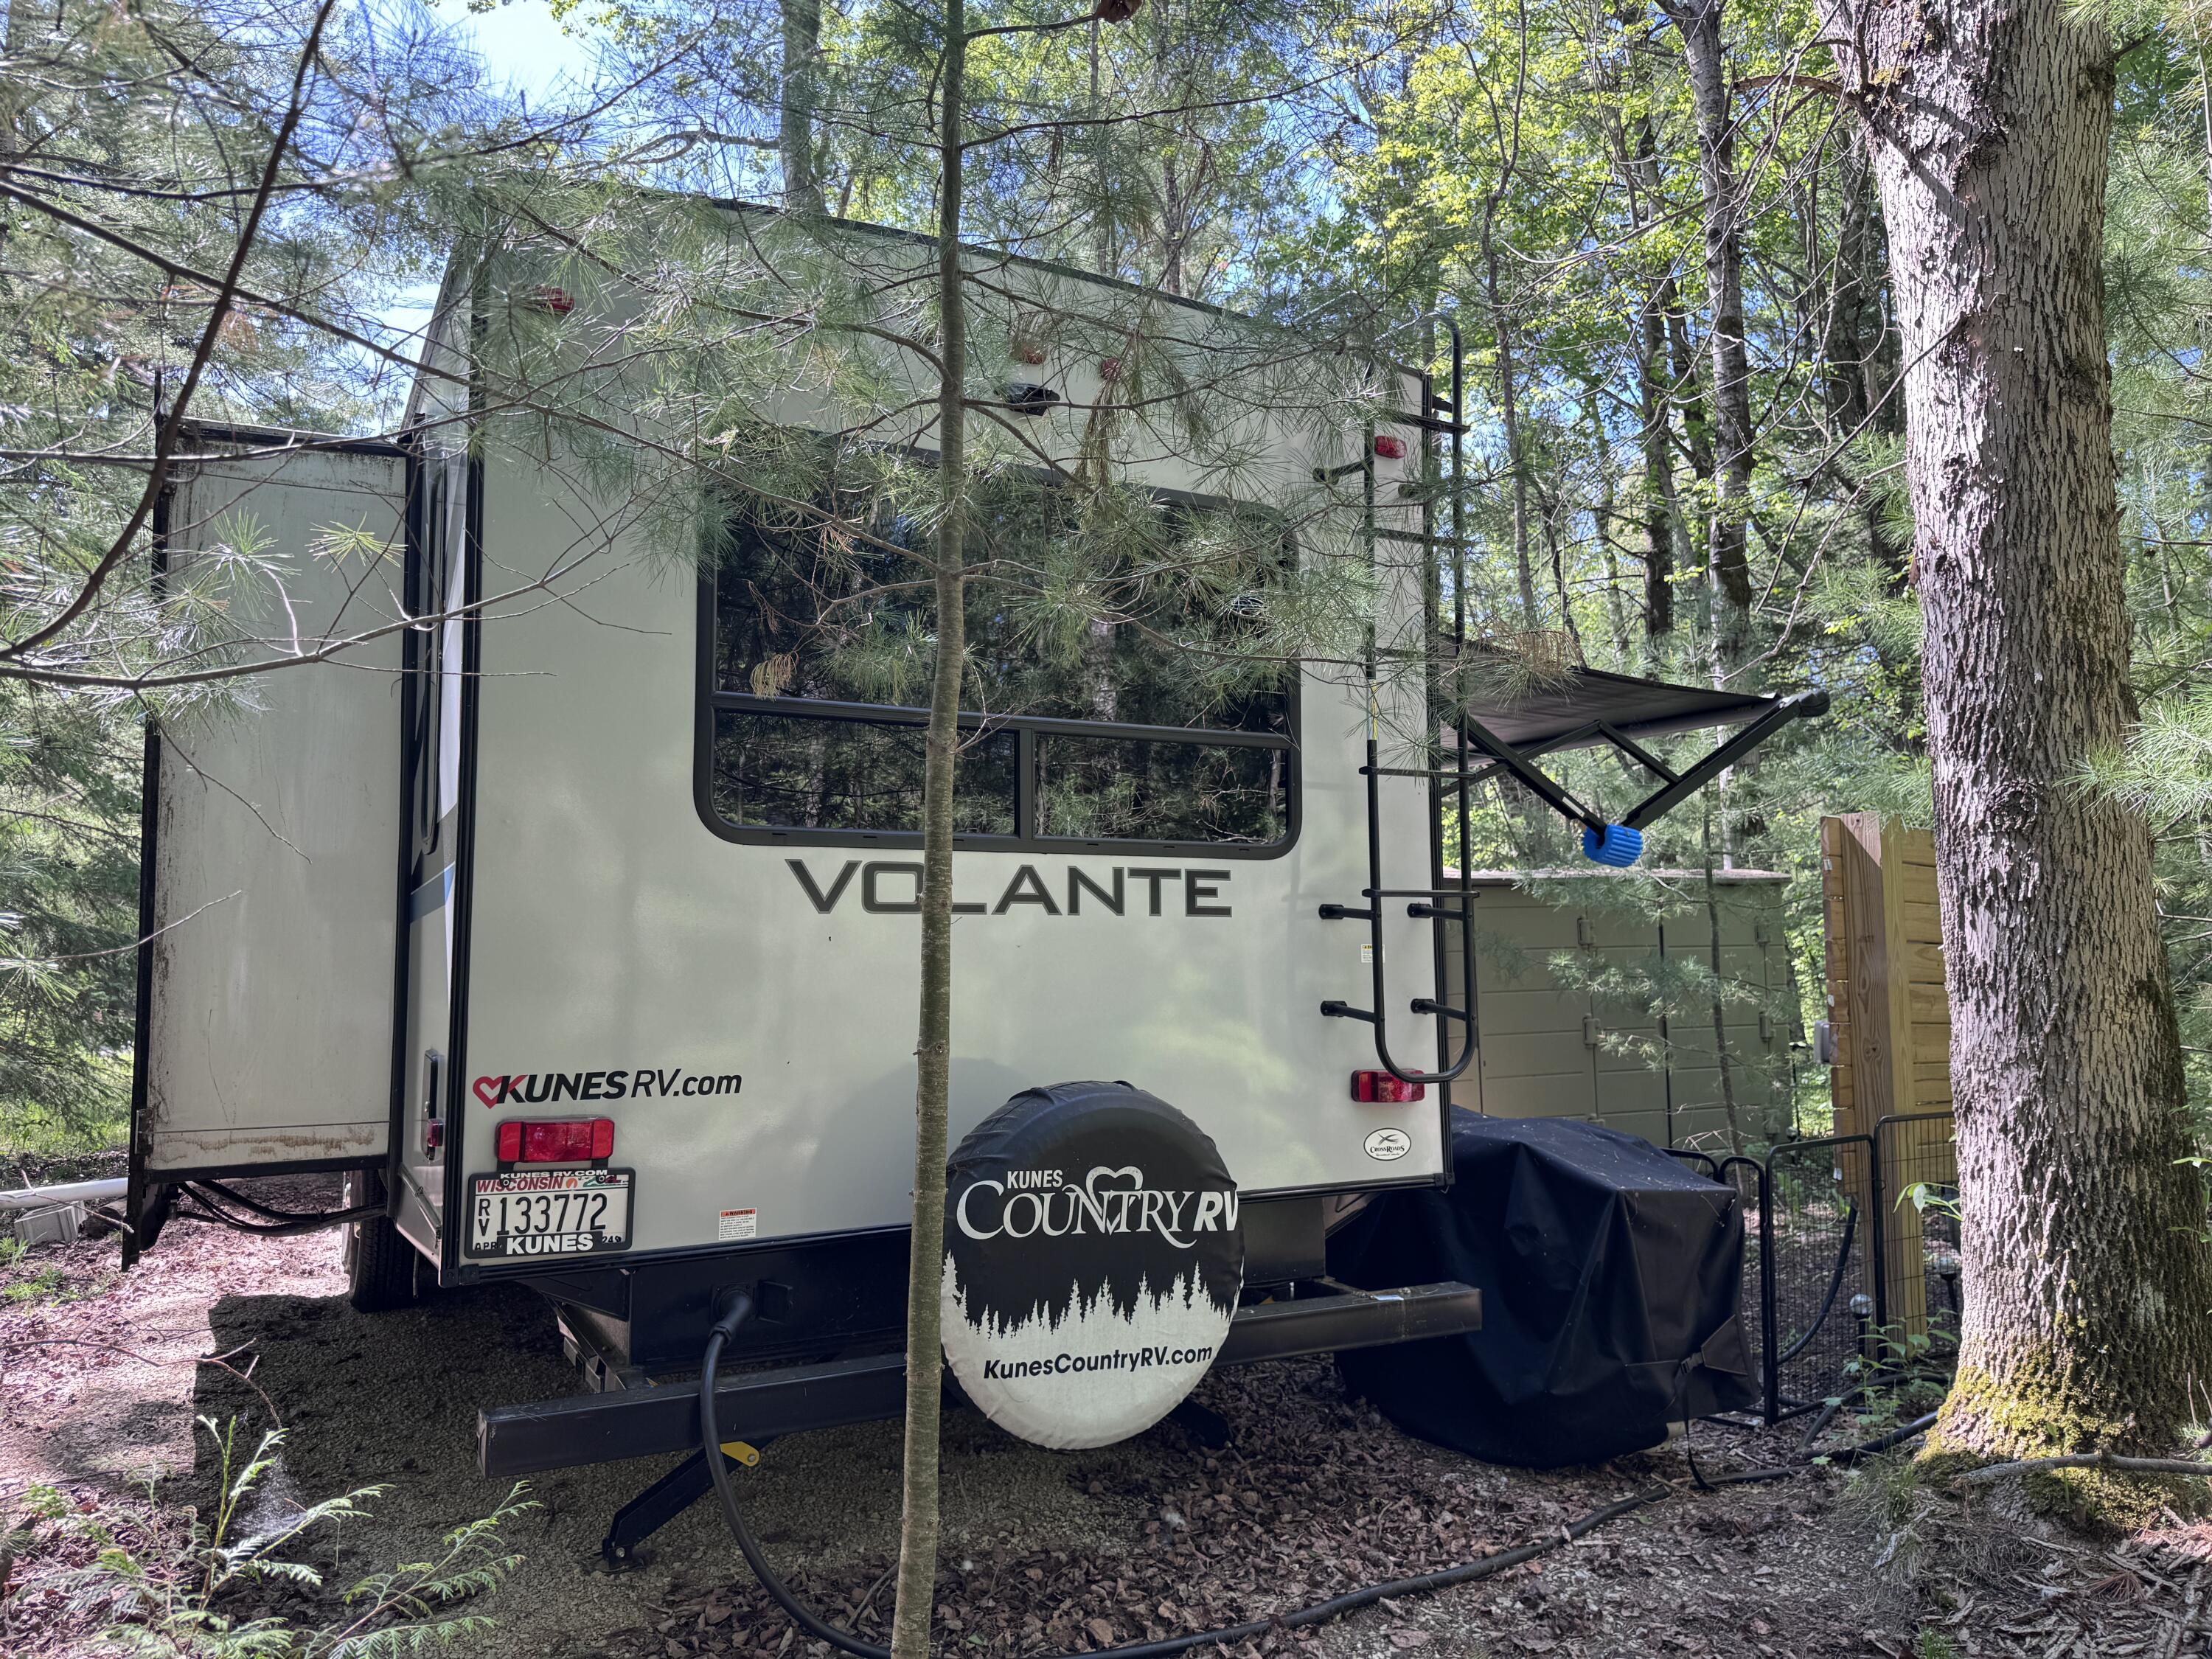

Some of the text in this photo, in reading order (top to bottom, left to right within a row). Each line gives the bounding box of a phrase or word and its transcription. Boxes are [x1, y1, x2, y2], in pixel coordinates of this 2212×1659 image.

[477, 1176, 564, 1193] WISCONSIN
[1007, 1169, 1063, 1189] KUNES
[497, 1193, 608, 1236] 133772
[1194, 1191, 1239, 1231] RV
[506, 1233, 594, 1255] KUNES
[983, 1345, 1213, 1380] KunesCountryRV.com
